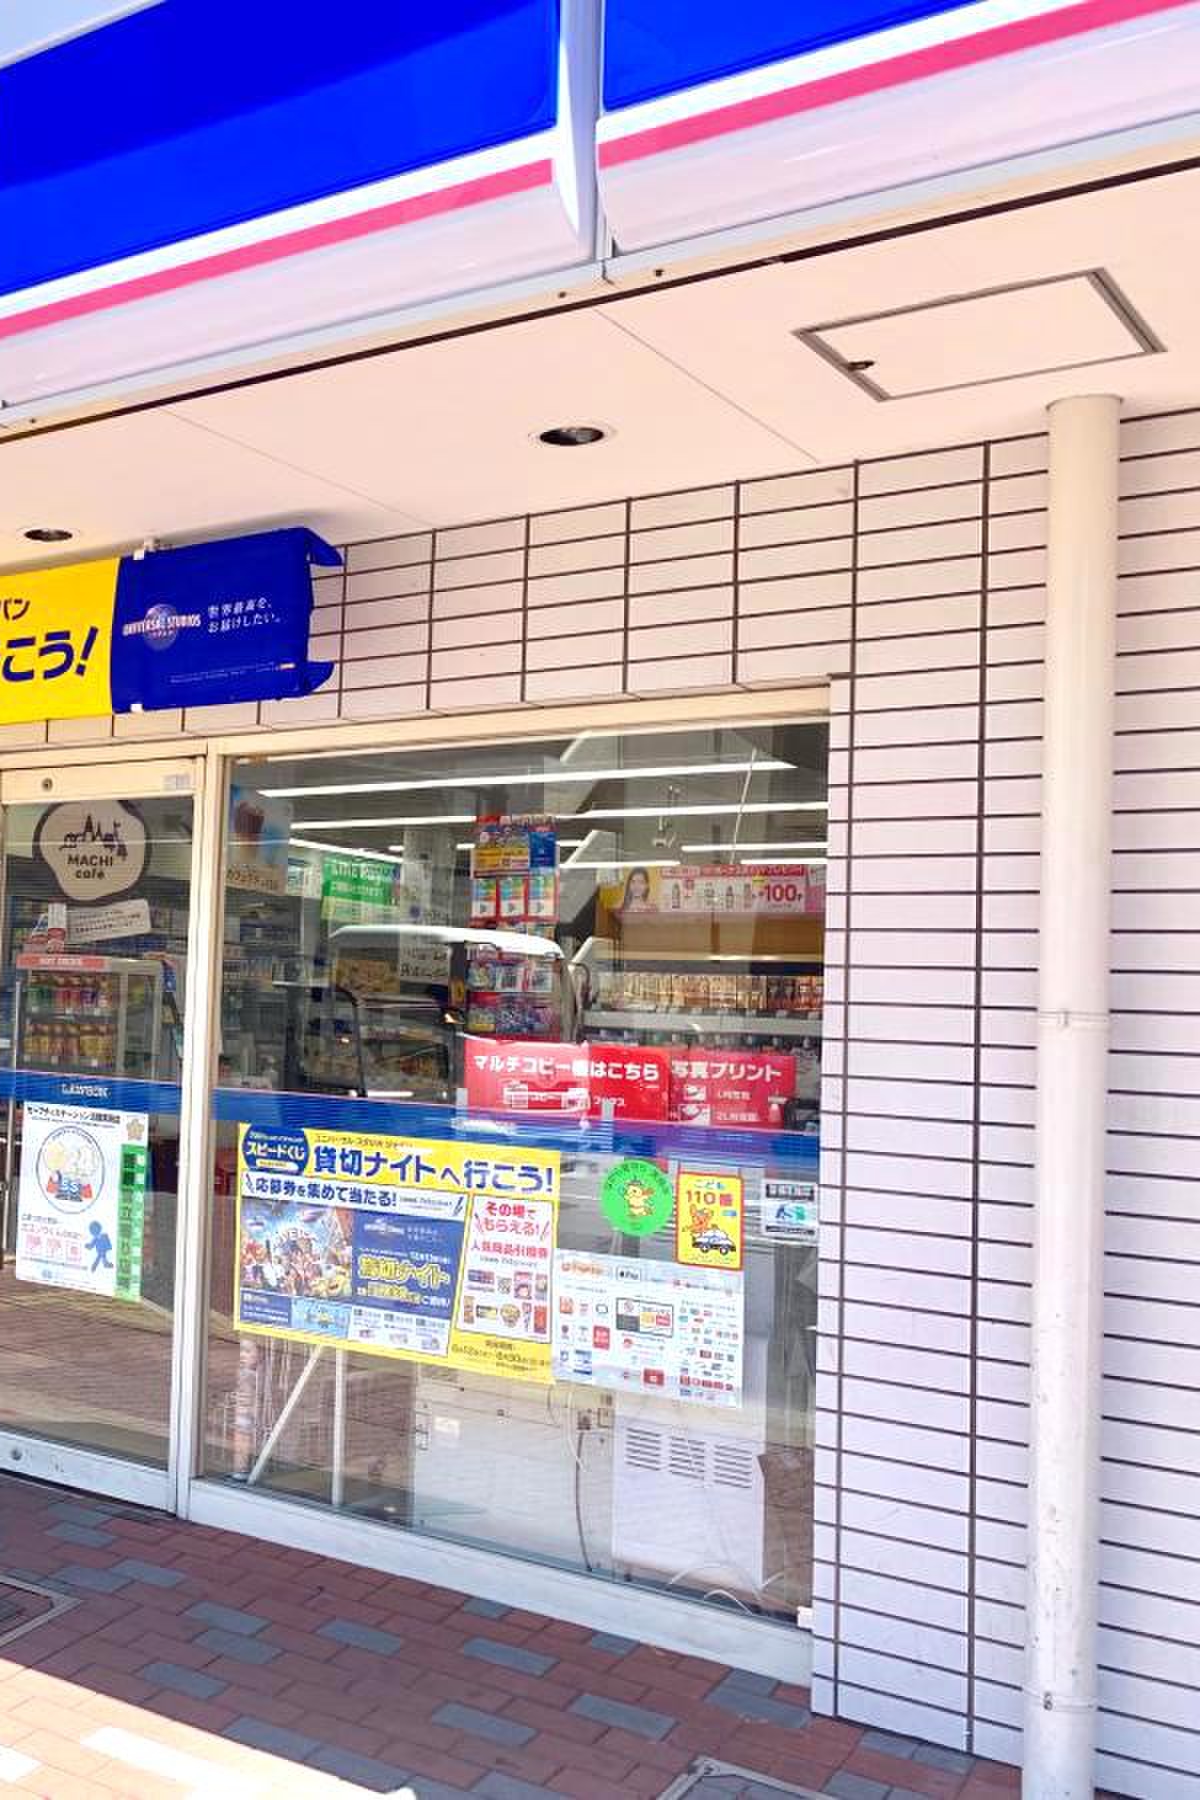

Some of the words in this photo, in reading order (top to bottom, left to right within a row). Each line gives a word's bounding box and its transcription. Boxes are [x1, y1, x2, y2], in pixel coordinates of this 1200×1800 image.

[67, 854, 113, 867] MACHI
[246, 1141, 304, 1161] スピードくじ
[314, 1146, 553, 1192] 貸切ナイトへ行こう!
[256, 1177, 397, 1207] 応募券を集めて当たる!
